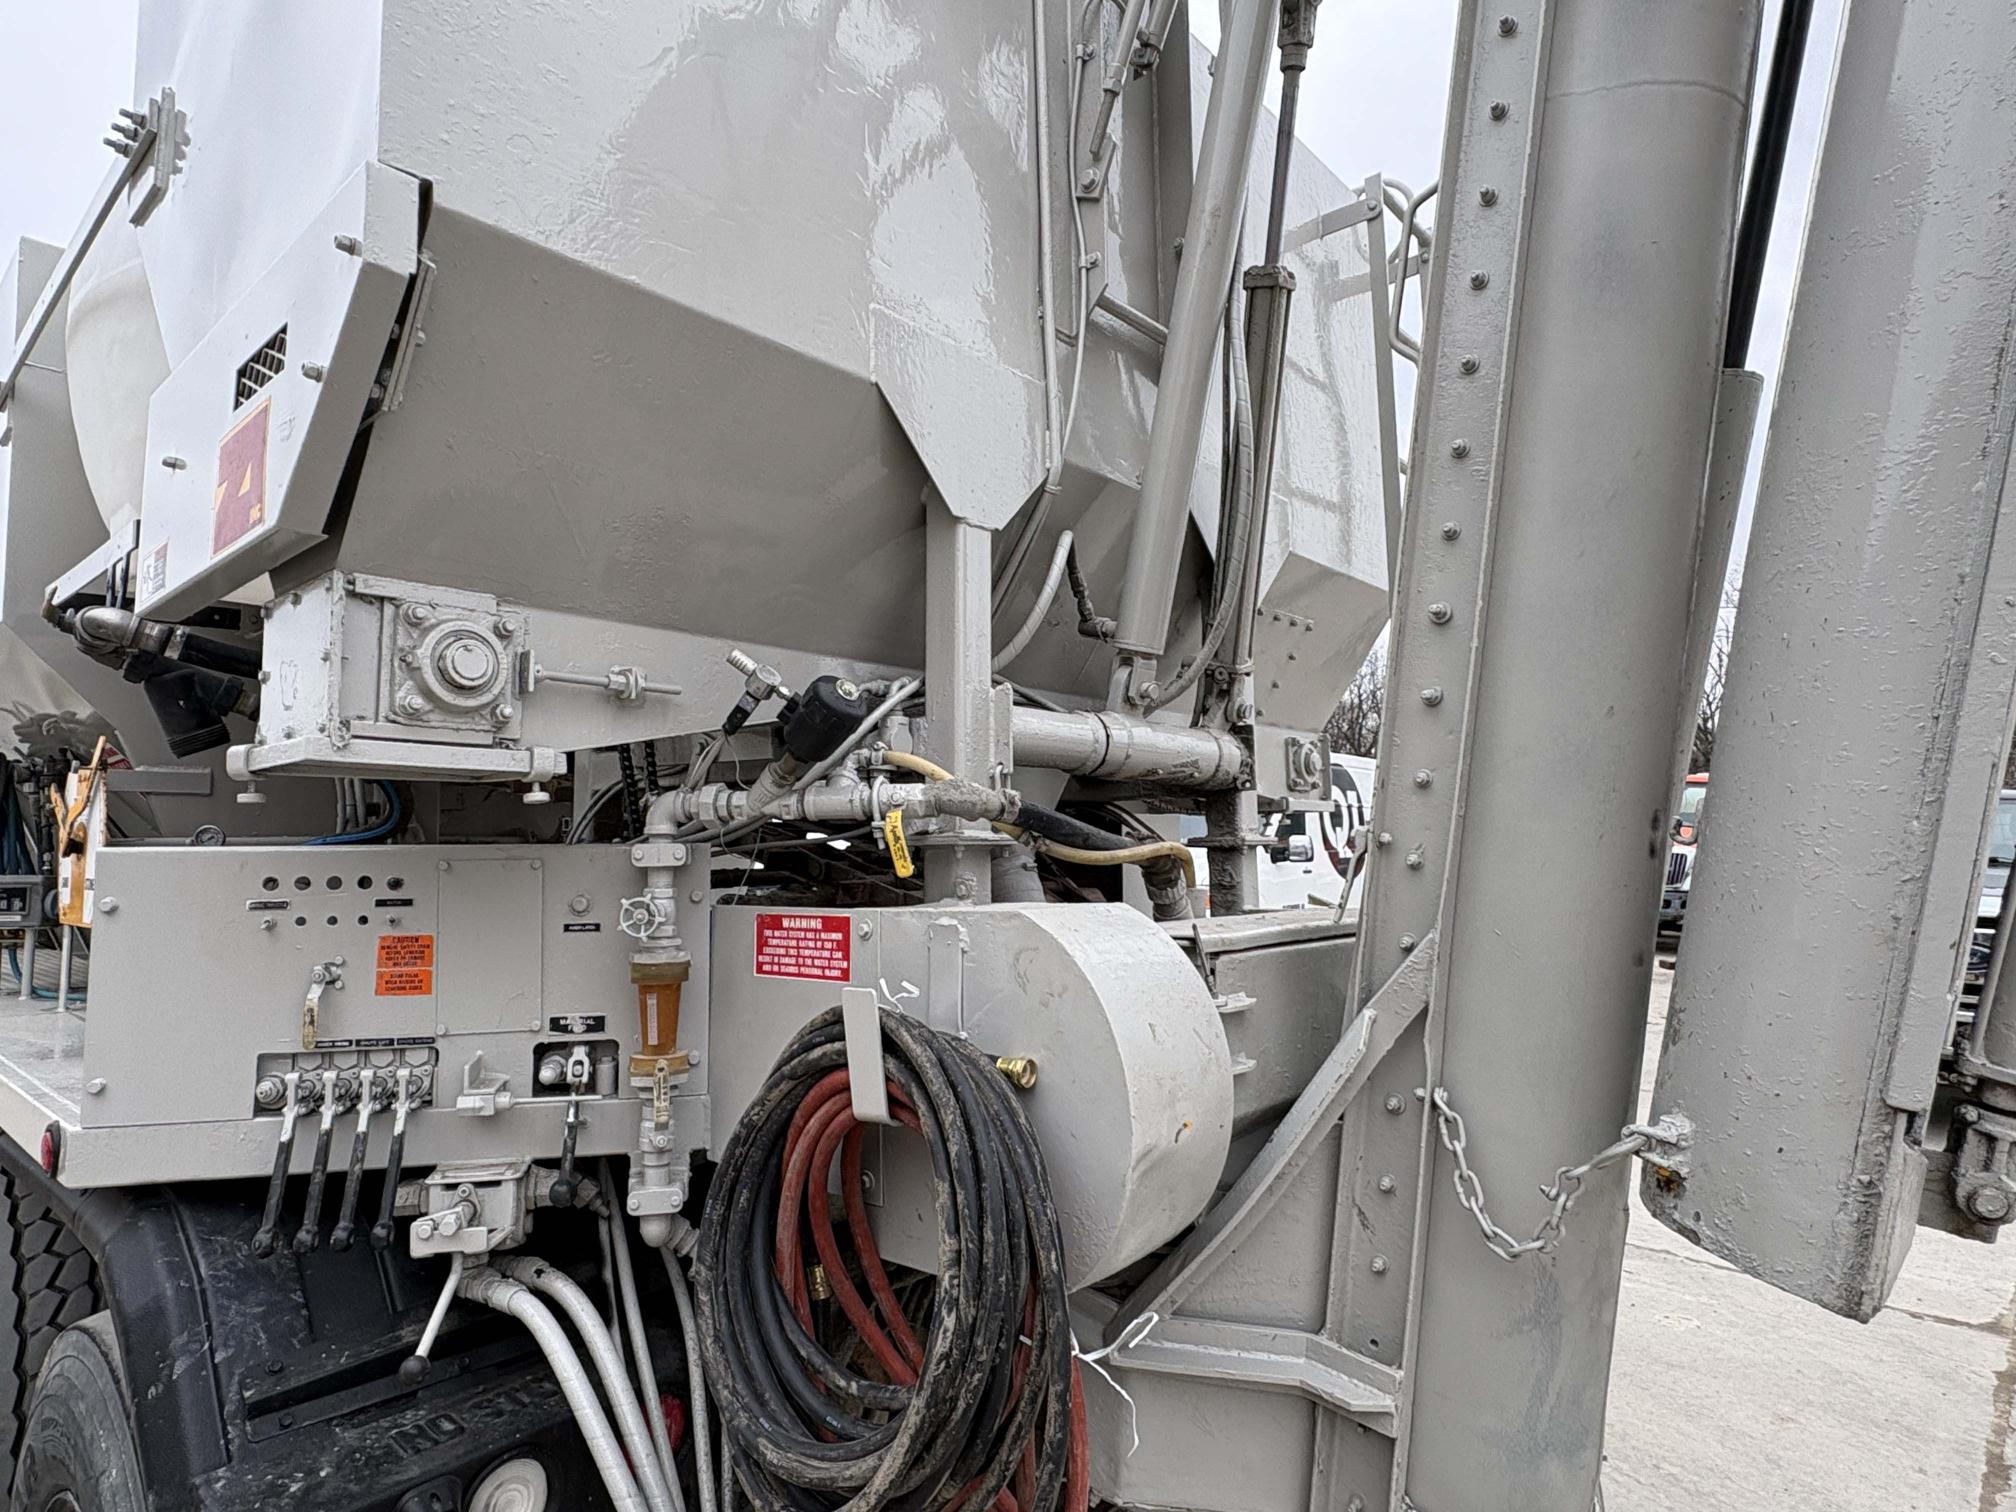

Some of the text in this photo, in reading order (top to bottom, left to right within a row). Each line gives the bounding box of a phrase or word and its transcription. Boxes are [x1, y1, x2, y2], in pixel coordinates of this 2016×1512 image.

[782, 917, 822, 929] WARNING
[768, 938, 797, 946] TEMPERATURE
[763, 947, 786, 955] EXCEEDING
[799, 949, 830, 958] TEMPERATURE
[800, 967, 823, 976] PERSONAL
[568, 1024, 587, 1032] FD
